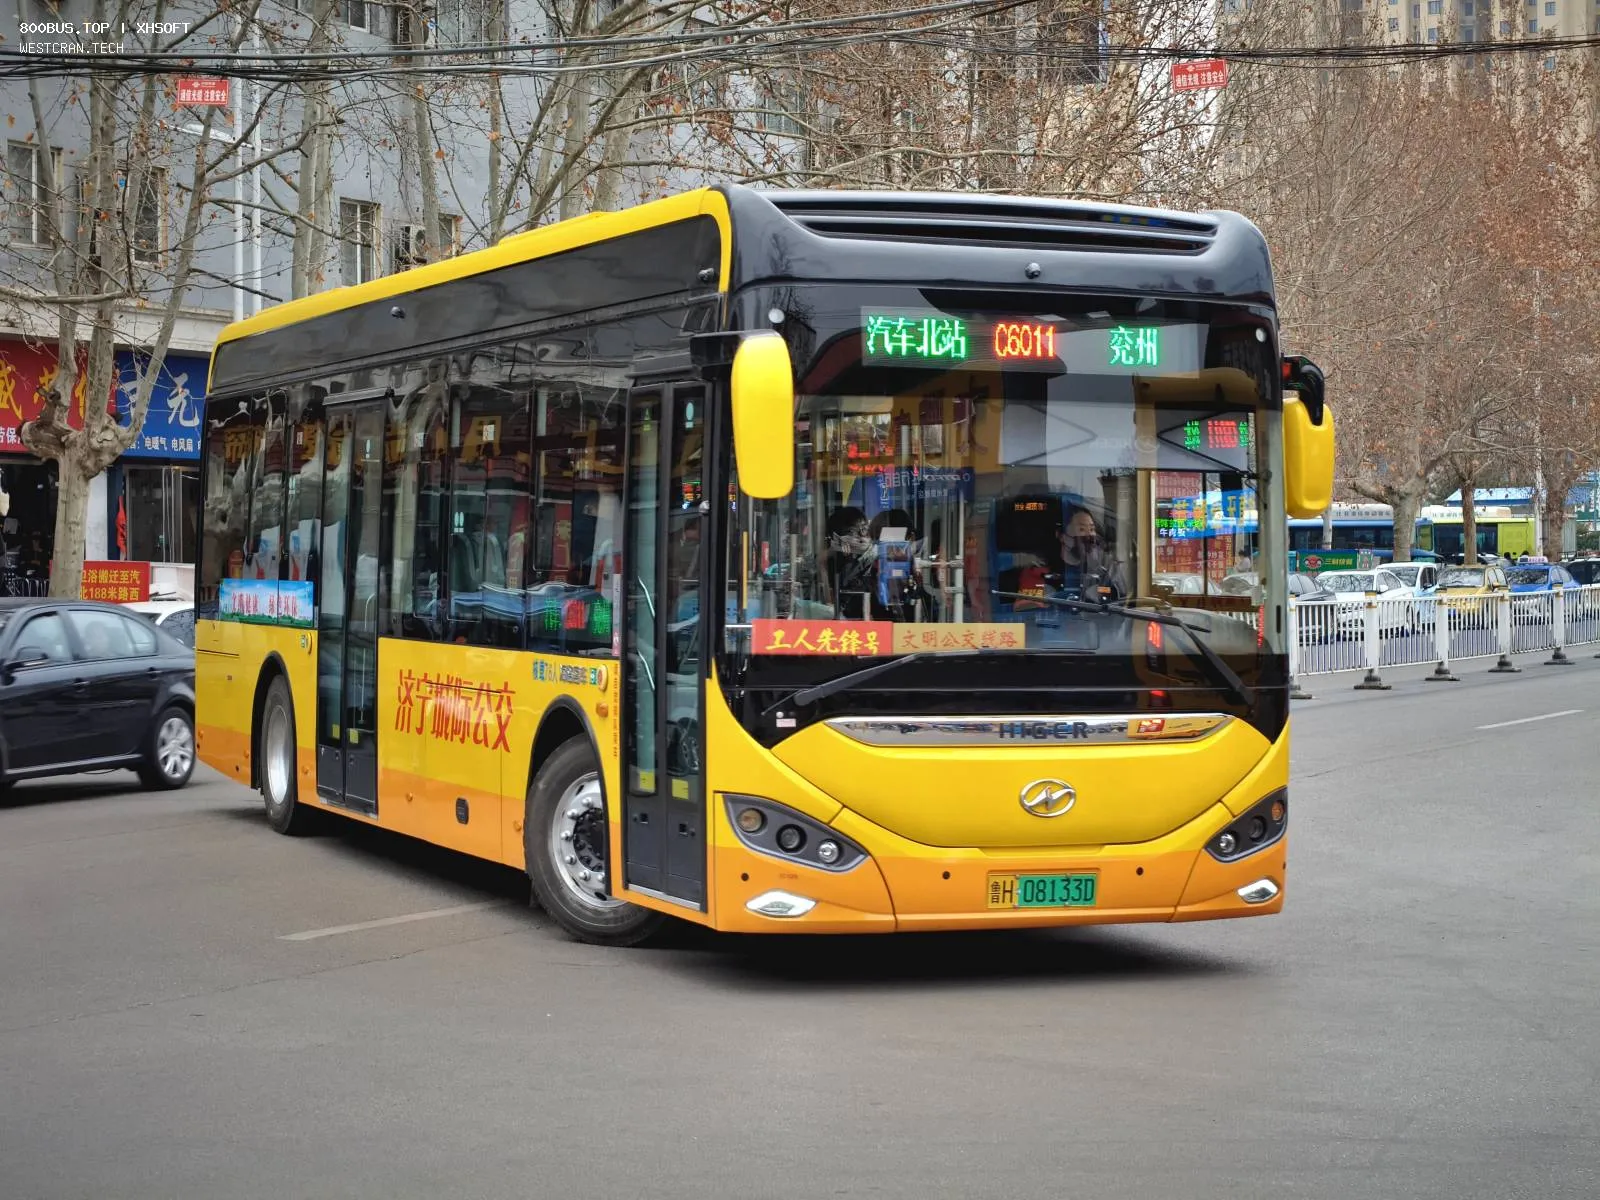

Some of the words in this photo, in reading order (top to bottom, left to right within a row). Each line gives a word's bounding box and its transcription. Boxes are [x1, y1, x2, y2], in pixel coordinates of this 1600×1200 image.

[866, 315, 967, 359] 汽车北站
[994, 322, 1056, 358] C6011
[1109, 325, 1159, 366] 兖州
[144, 436, 167, 452] 电暖气
[171, 437, 193, 453] 电风扇
[394, 667, 517, 754] 济宁城际公交
[999, 721, 1089, 739] HIGER
